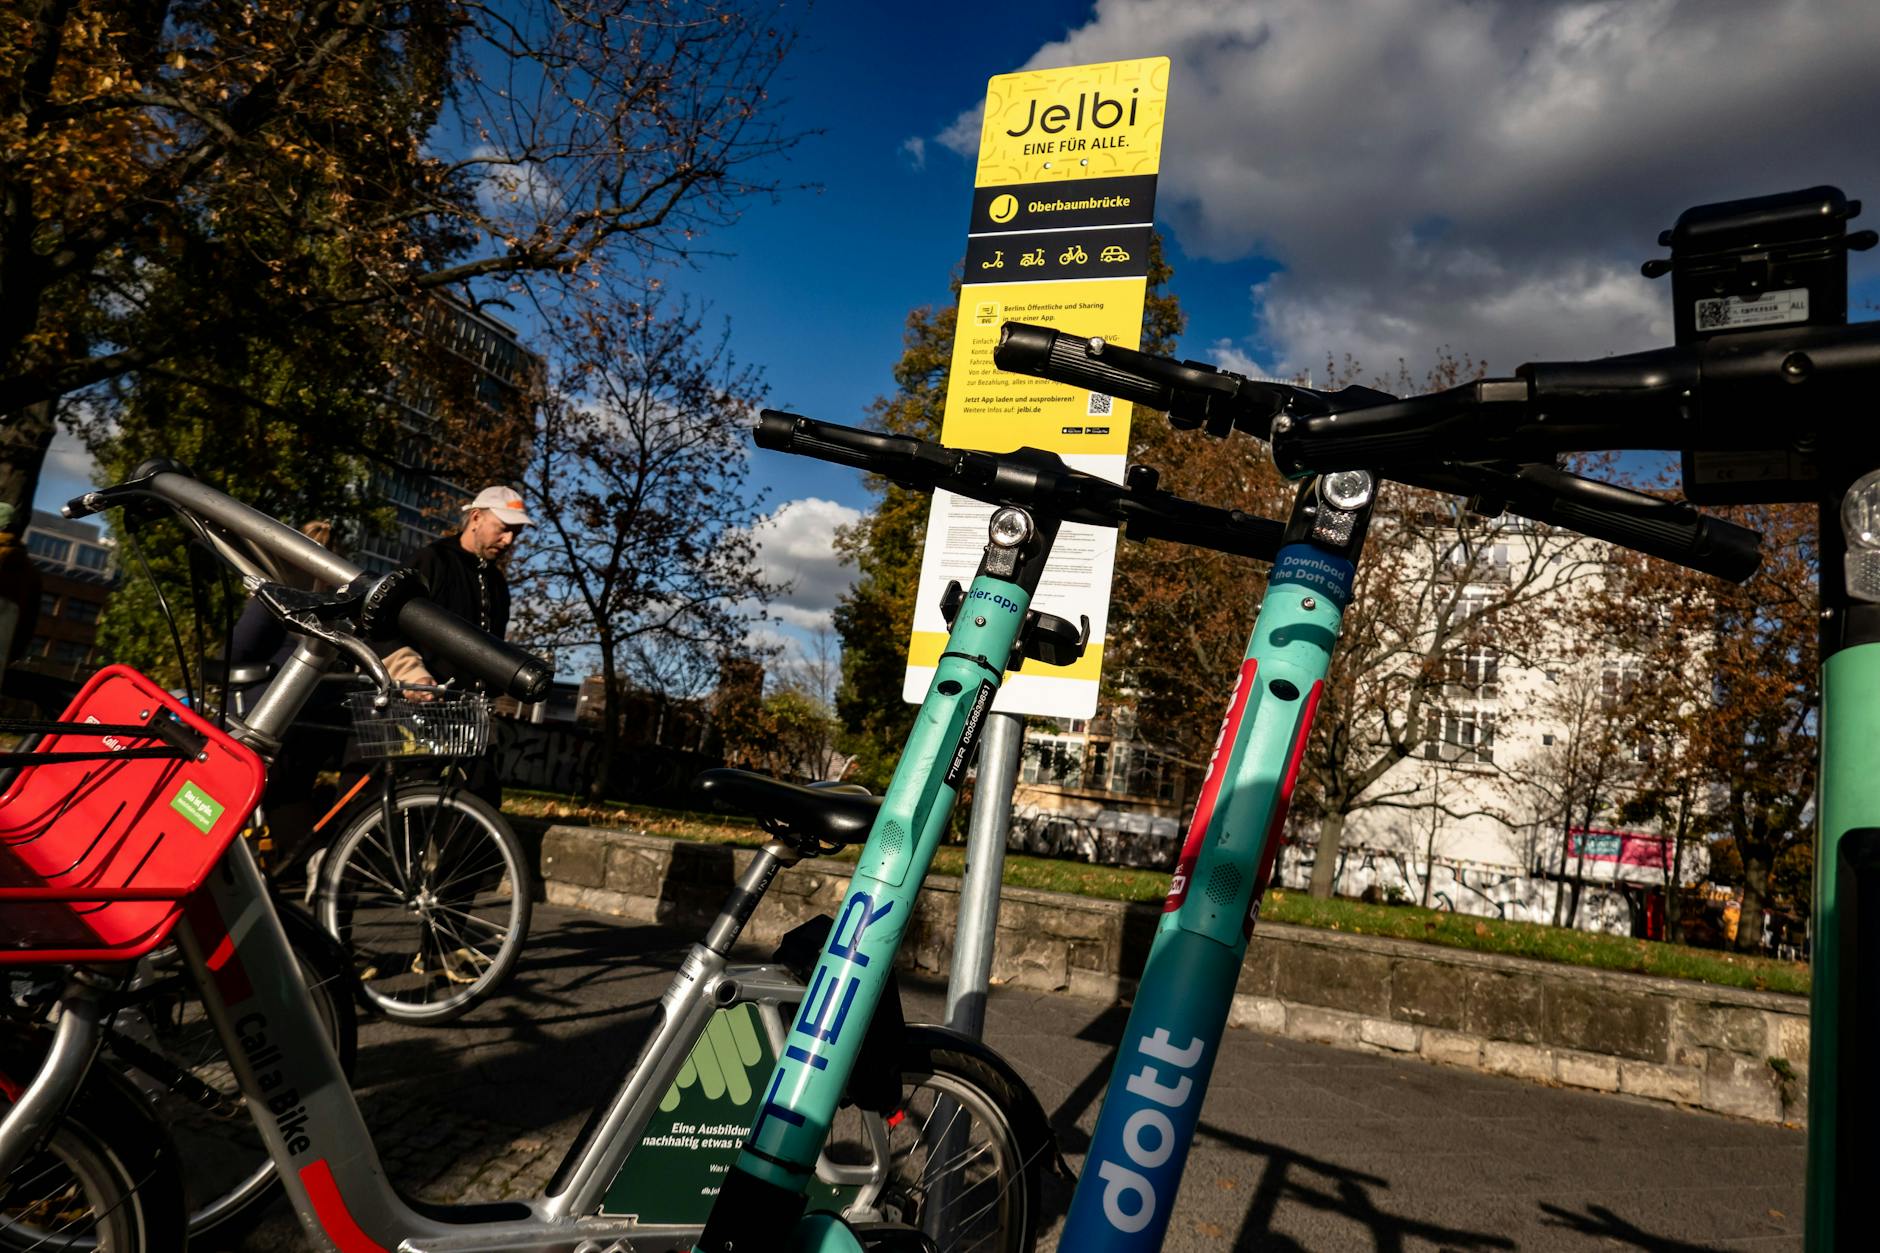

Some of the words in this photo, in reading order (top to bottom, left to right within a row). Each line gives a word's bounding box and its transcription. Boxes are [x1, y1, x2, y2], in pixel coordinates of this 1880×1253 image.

[1006, 87, 1140, 138] Jelbi
[1023, 141, 1055, 156] EINE
[1059, 137, 1087, 152] FÜR
[1090, 135, 1130, 150] ALLE.
[1028, 195, 1131, 213] Oberbaumbrücke
[1027, 303, 1063, 311] Öffentliche
[1078, 302, 1104, 310] Sharing
[981, 396, 994, 404] App
[995, 395, 1014, 403] laden
[1028, 395, 1075, 404] ausprobieren!
[1016, 406, 1042, 414] jelbi.de
[1283, 556, 1347, 581] Download
[1275, 569, 1293, 580] the
[1295, 568, 1326, 585] Dott
[1327, 580, 1346, 600] app
[947, 747, 967, 781] TIER
[750, 890, 895, 1146] TIER
[234, 1011, 283, 1072] Call
[257, 1069, 283, 1092] a
[268, 1088, 311, 1157] Bike
[671, 1122, 696, 1134] Eine
[697, 1122, 751, 1136] Ausbildun
[1098, 1027, 1205, 1233] dott
[642, 1136, 700, 1150] nachhaltig
[701, 1138, 733, 1149] etwas
[709, 1164, 723, 1173] Was
